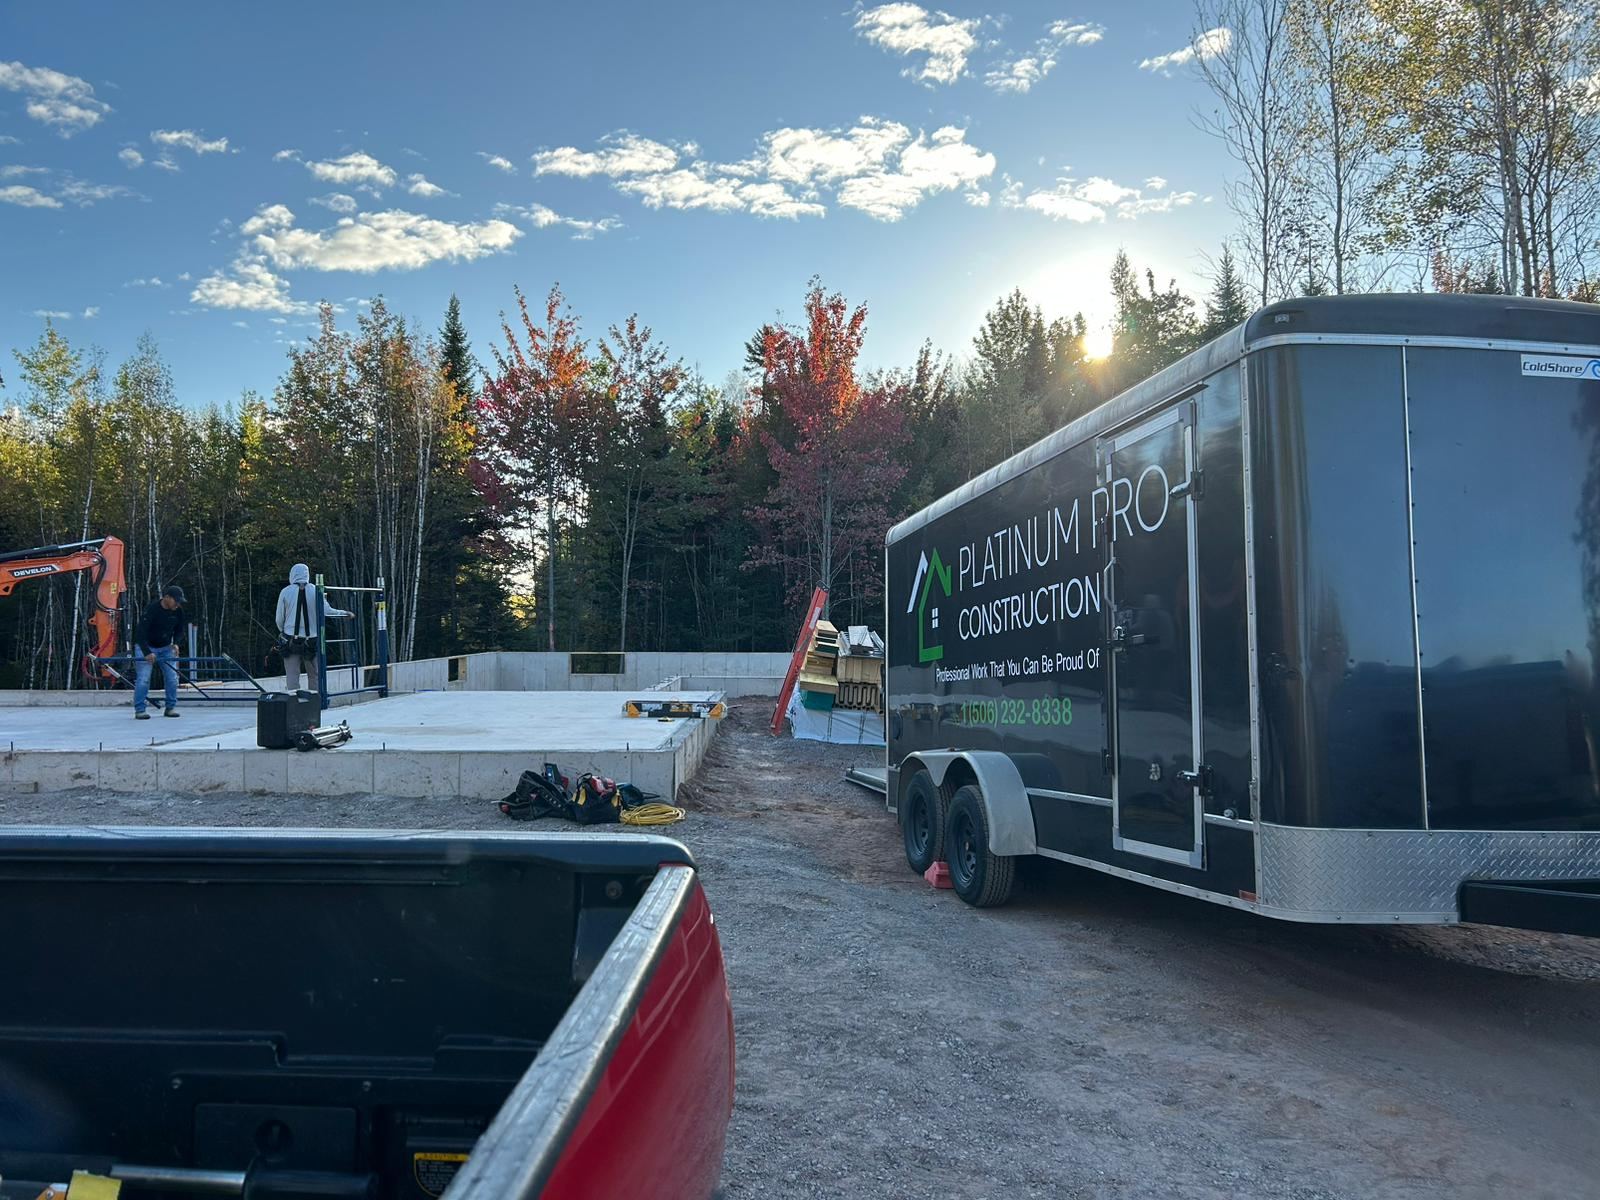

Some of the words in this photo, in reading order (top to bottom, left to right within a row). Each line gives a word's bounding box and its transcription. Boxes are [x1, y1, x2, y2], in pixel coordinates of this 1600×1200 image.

[1523, 361, 1583, 374] ColdShore
[959, 498, 1079, 591] PLATINUM
[1092, 464, 1169, 549] PRO
[13, 566, 52, 577] DEVELON
[958, 572, 1100, 641] CONSTRUCTION
[936, 666, 970, 682] Professional
[971, 662, 988, 679] Work
[990, 660, 1005, 678] That
[1006, 658, 1021, 676] You
[1022, 656, 1039, 675] Can
[1041, 654, 1053, 673] Be
[1056, 650, 1083, 671] Proud
[1087, 648, 1100, 669] Of
[1000, 697, 1073, 725] 232-8338
